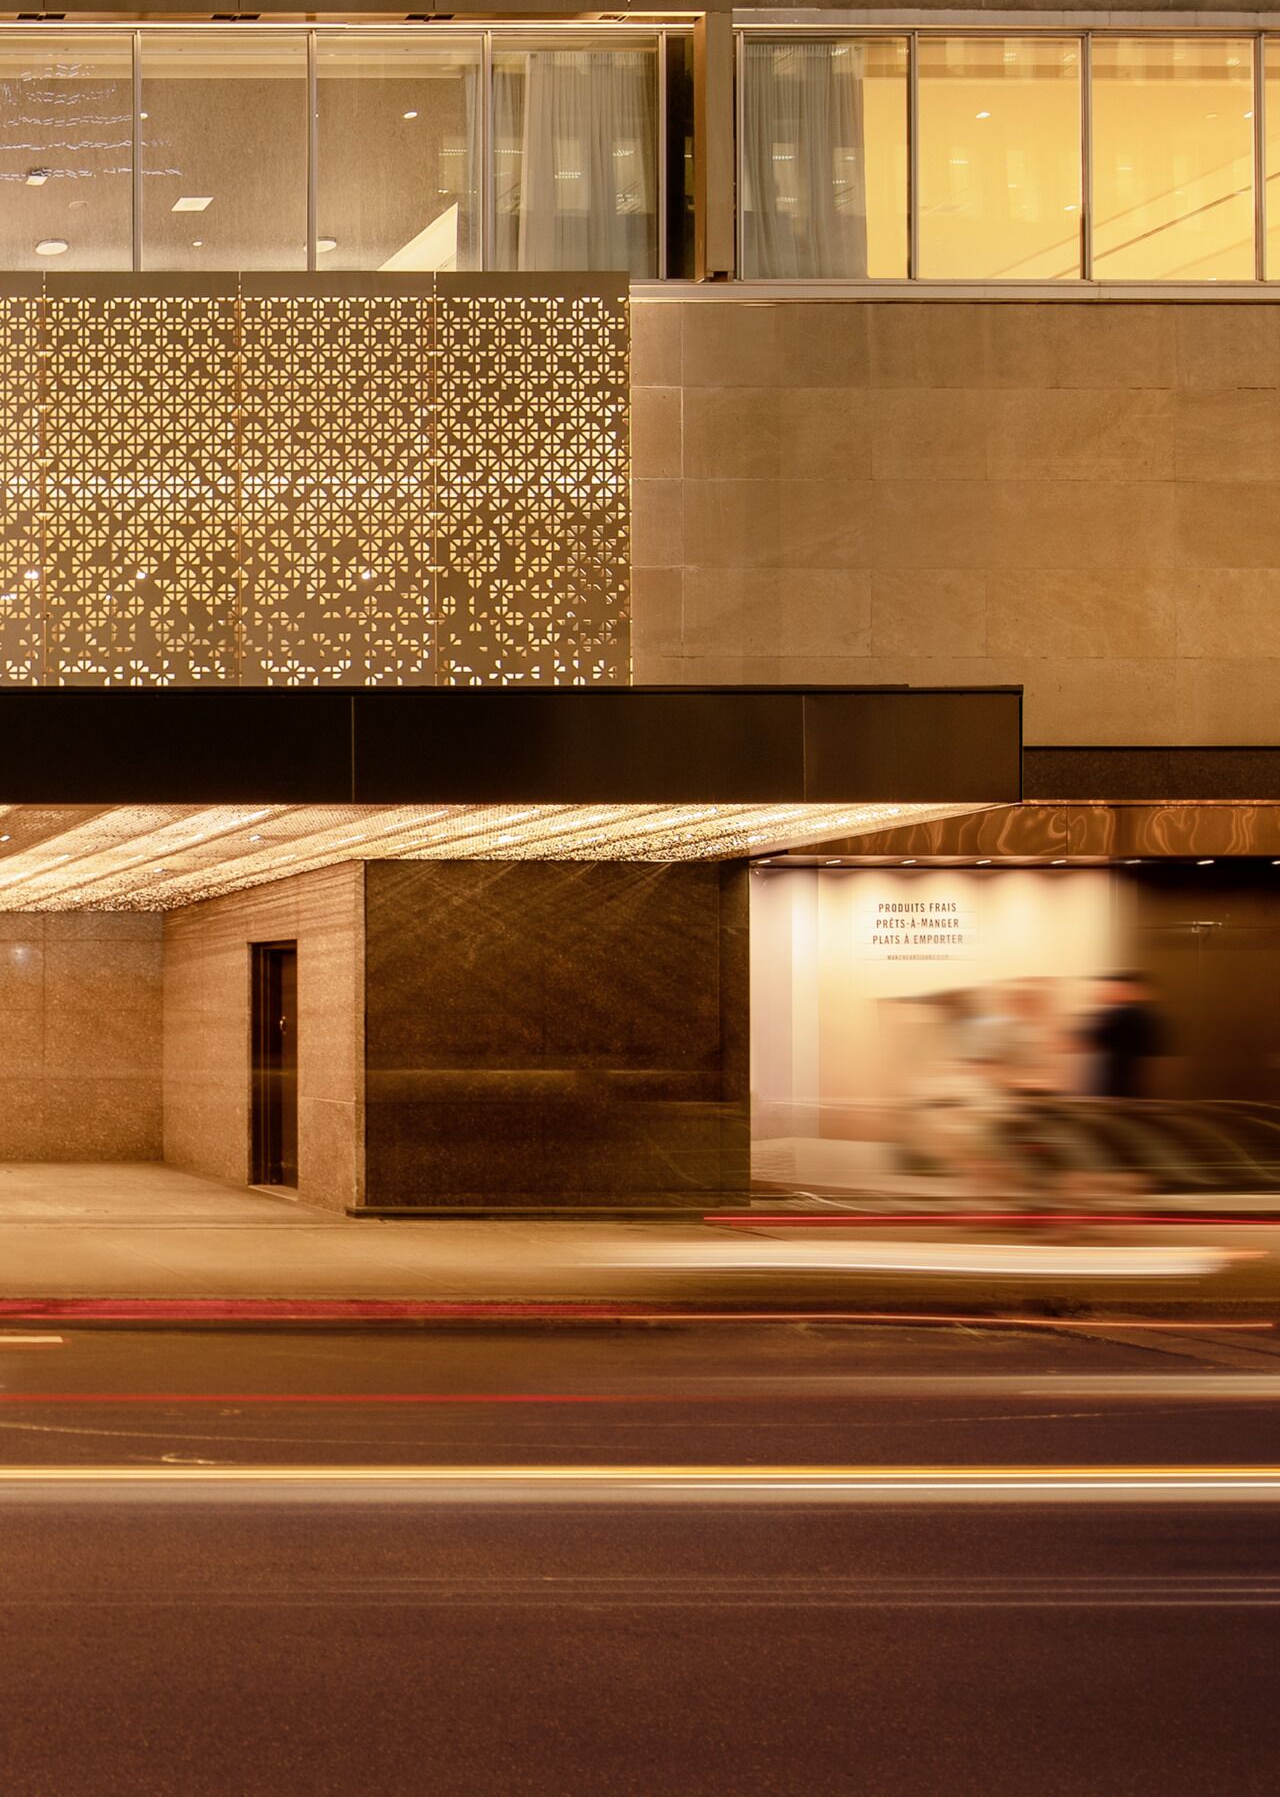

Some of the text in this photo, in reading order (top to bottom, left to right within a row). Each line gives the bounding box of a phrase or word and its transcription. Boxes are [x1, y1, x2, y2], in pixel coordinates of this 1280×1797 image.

[878, 903, 957, 913] PRODUITS FRAIS
[872, 935, 901, 945] PLATS
[913, 934, 964, 944] EMPORTER
